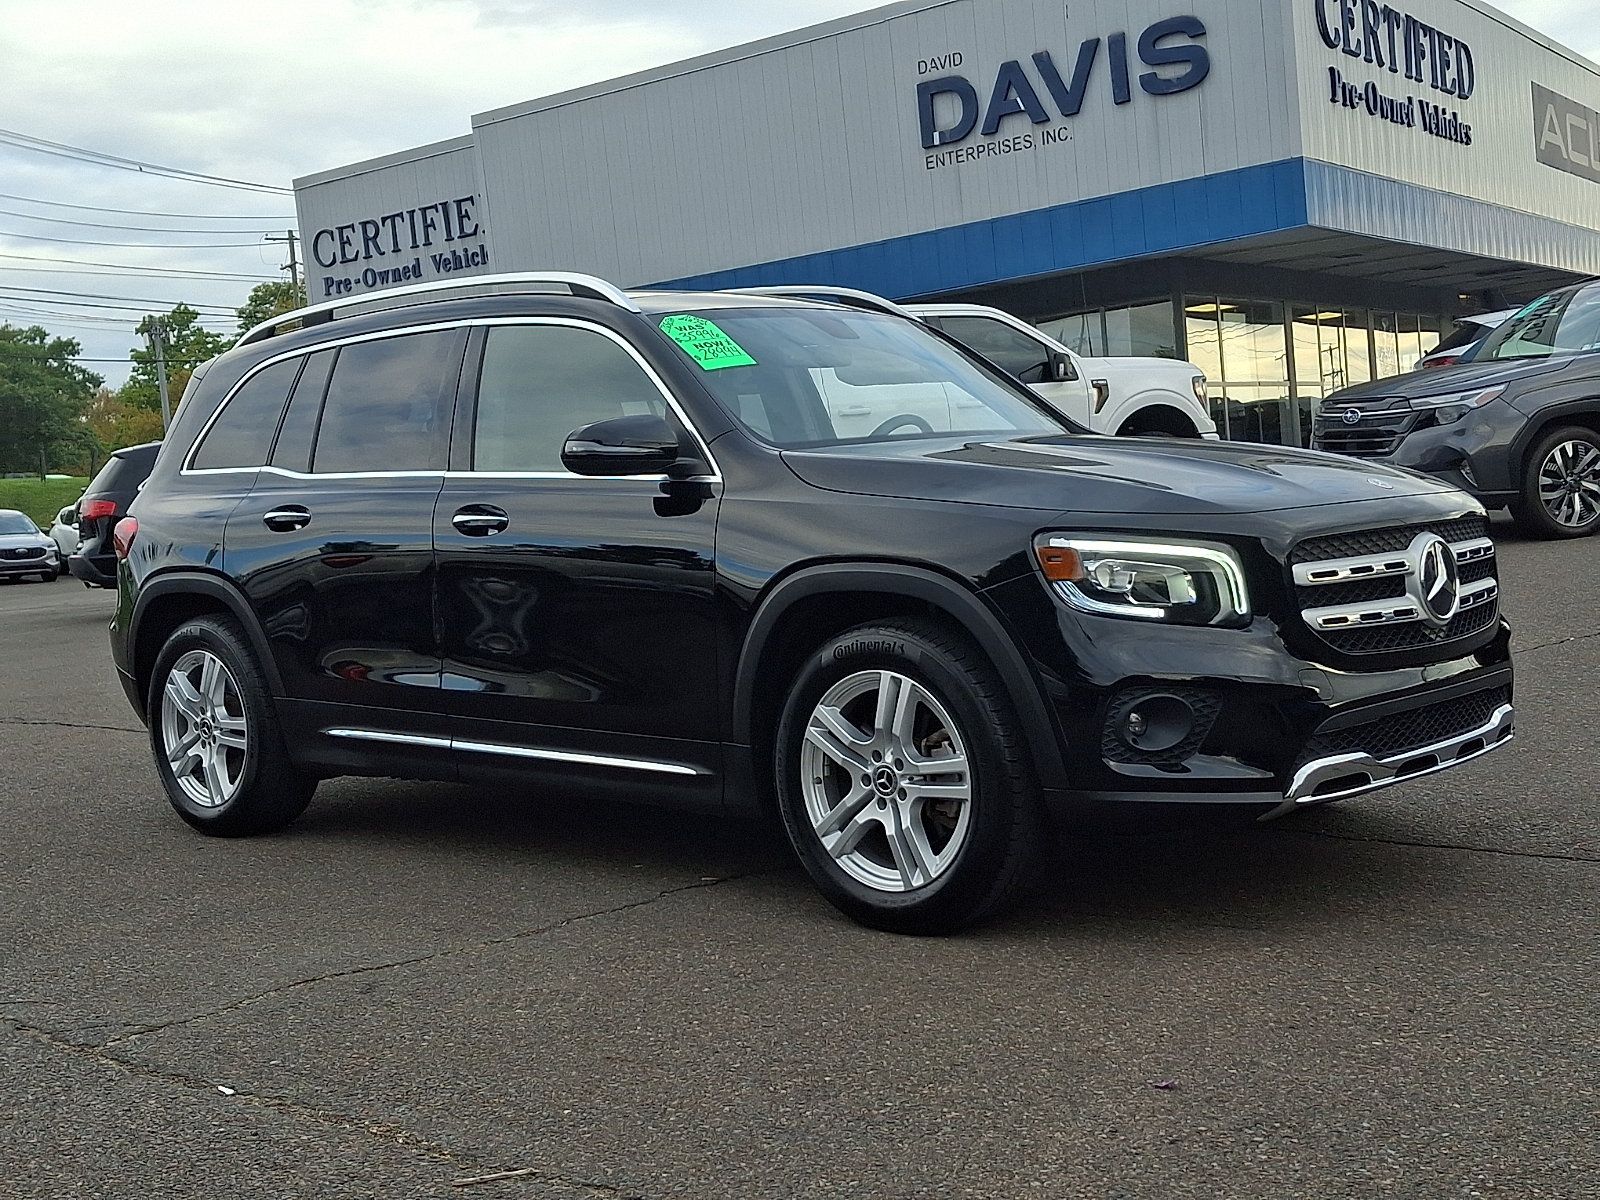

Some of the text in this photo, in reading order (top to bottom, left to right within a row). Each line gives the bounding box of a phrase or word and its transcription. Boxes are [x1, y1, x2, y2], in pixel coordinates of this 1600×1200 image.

[917, 52, 963, 75] DAVID
[1315, 0, 1475, 100] CERTIFIED
[916, 15, 1211, 150] DAVIS
[1328, 66, 1473, 146] Pre-Owned Vehicles
[925, 126, 1073, 171] ENTERPRISES, INC.
[312, 193, 487, 268] CERTIFIE
[322, 244, 489, 297] Pre-Owned Vehicl
[674, 324, 705, 332] WAS
[832, 640, 898, 660] Continental
